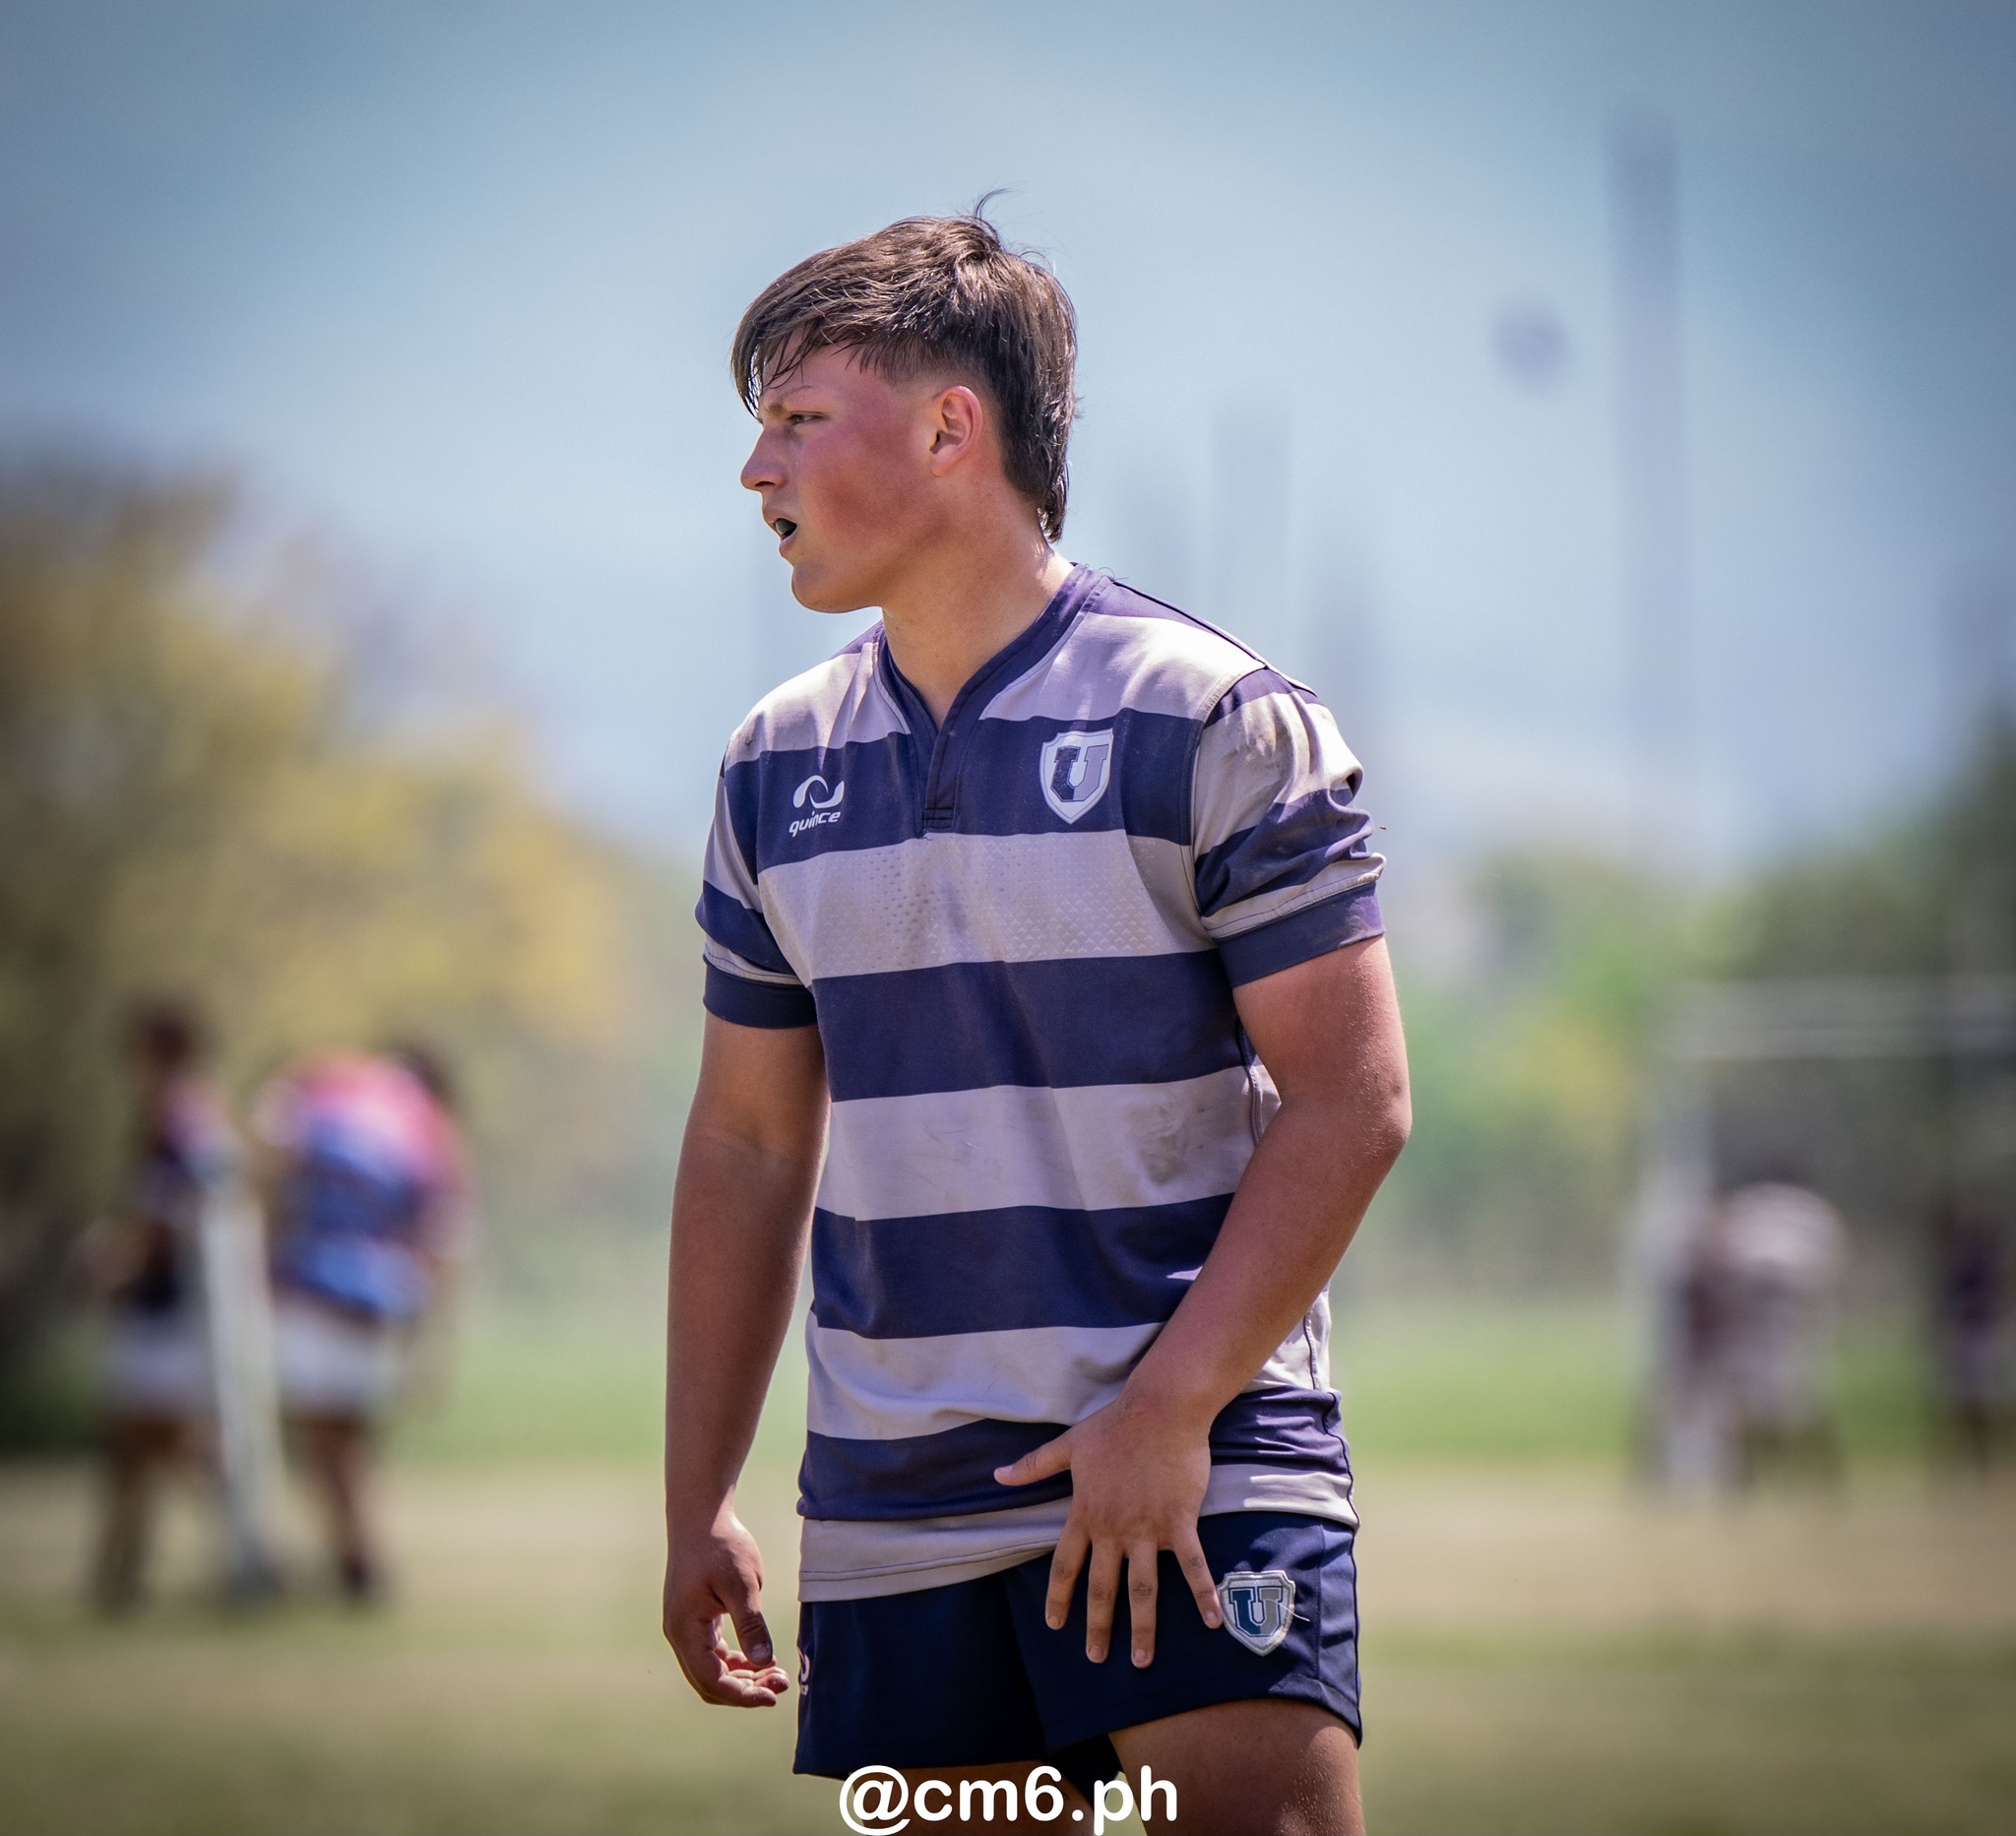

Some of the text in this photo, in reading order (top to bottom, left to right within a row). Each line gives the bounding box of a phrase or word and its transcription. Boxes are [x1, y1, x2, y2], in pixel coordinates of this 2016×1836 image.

[1049, 743, 1109, 803] U
[788, 810, 842, 838] quince
[1228, 1585, 1284, 1638] U
